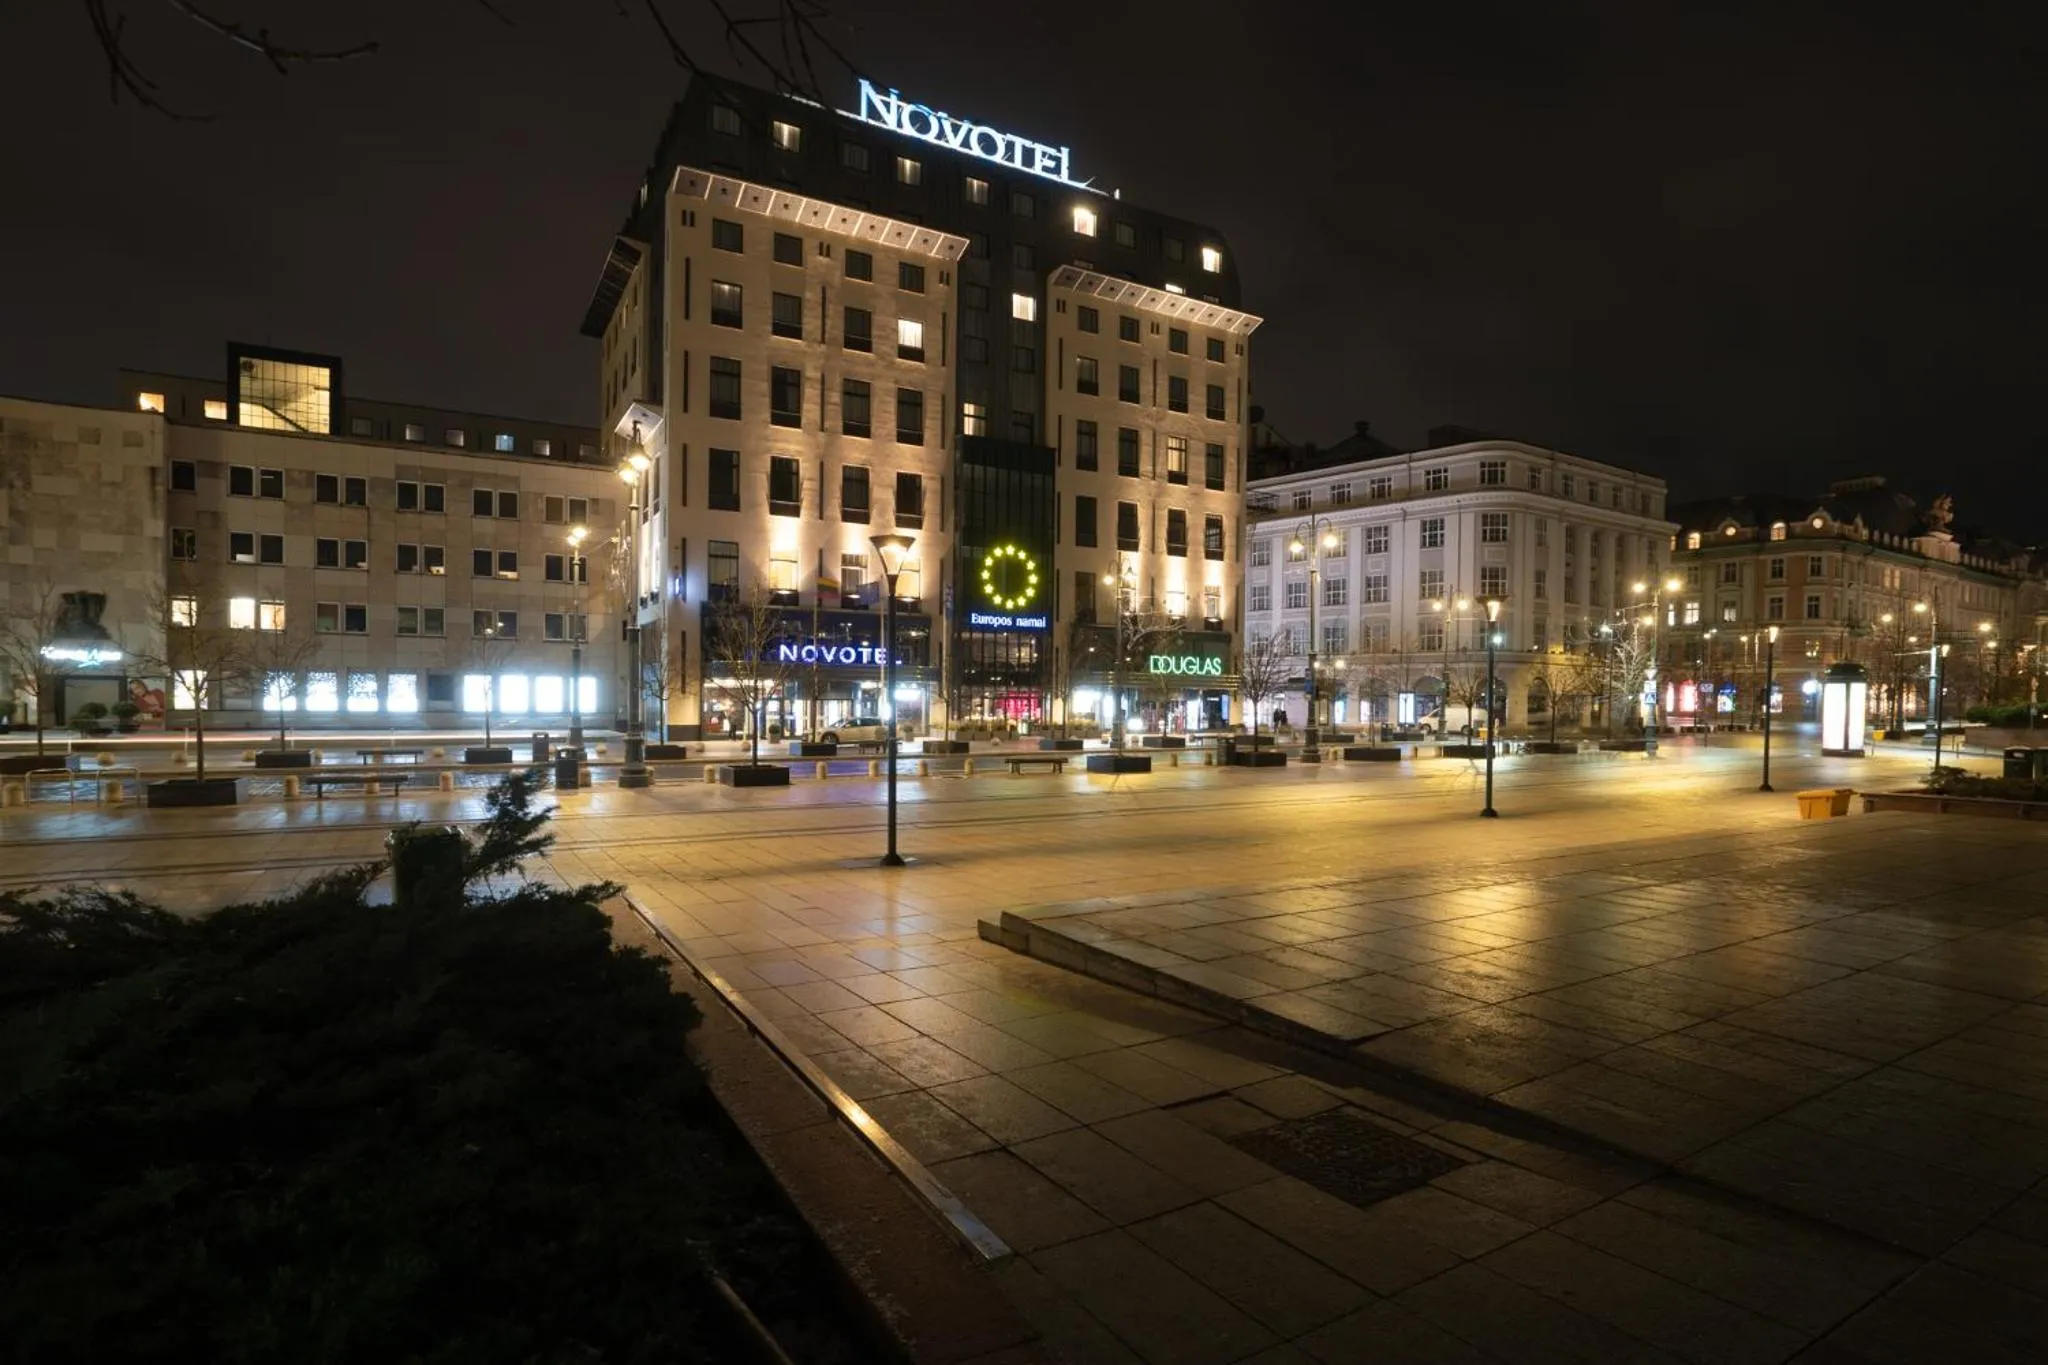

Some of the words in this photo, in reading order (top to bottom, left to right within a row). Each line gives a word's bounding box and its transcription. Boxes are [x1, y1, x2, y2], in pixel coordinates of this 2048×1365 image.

[857, 78, 1073, 183] NOVOTEL
[971, 613, 1012, 627] Europos
[1016, 616, 1046, 628] namai
[779, 644, 903, 665] NOVOTE
[1150, 655, 1222, 675] DOUGLAS
